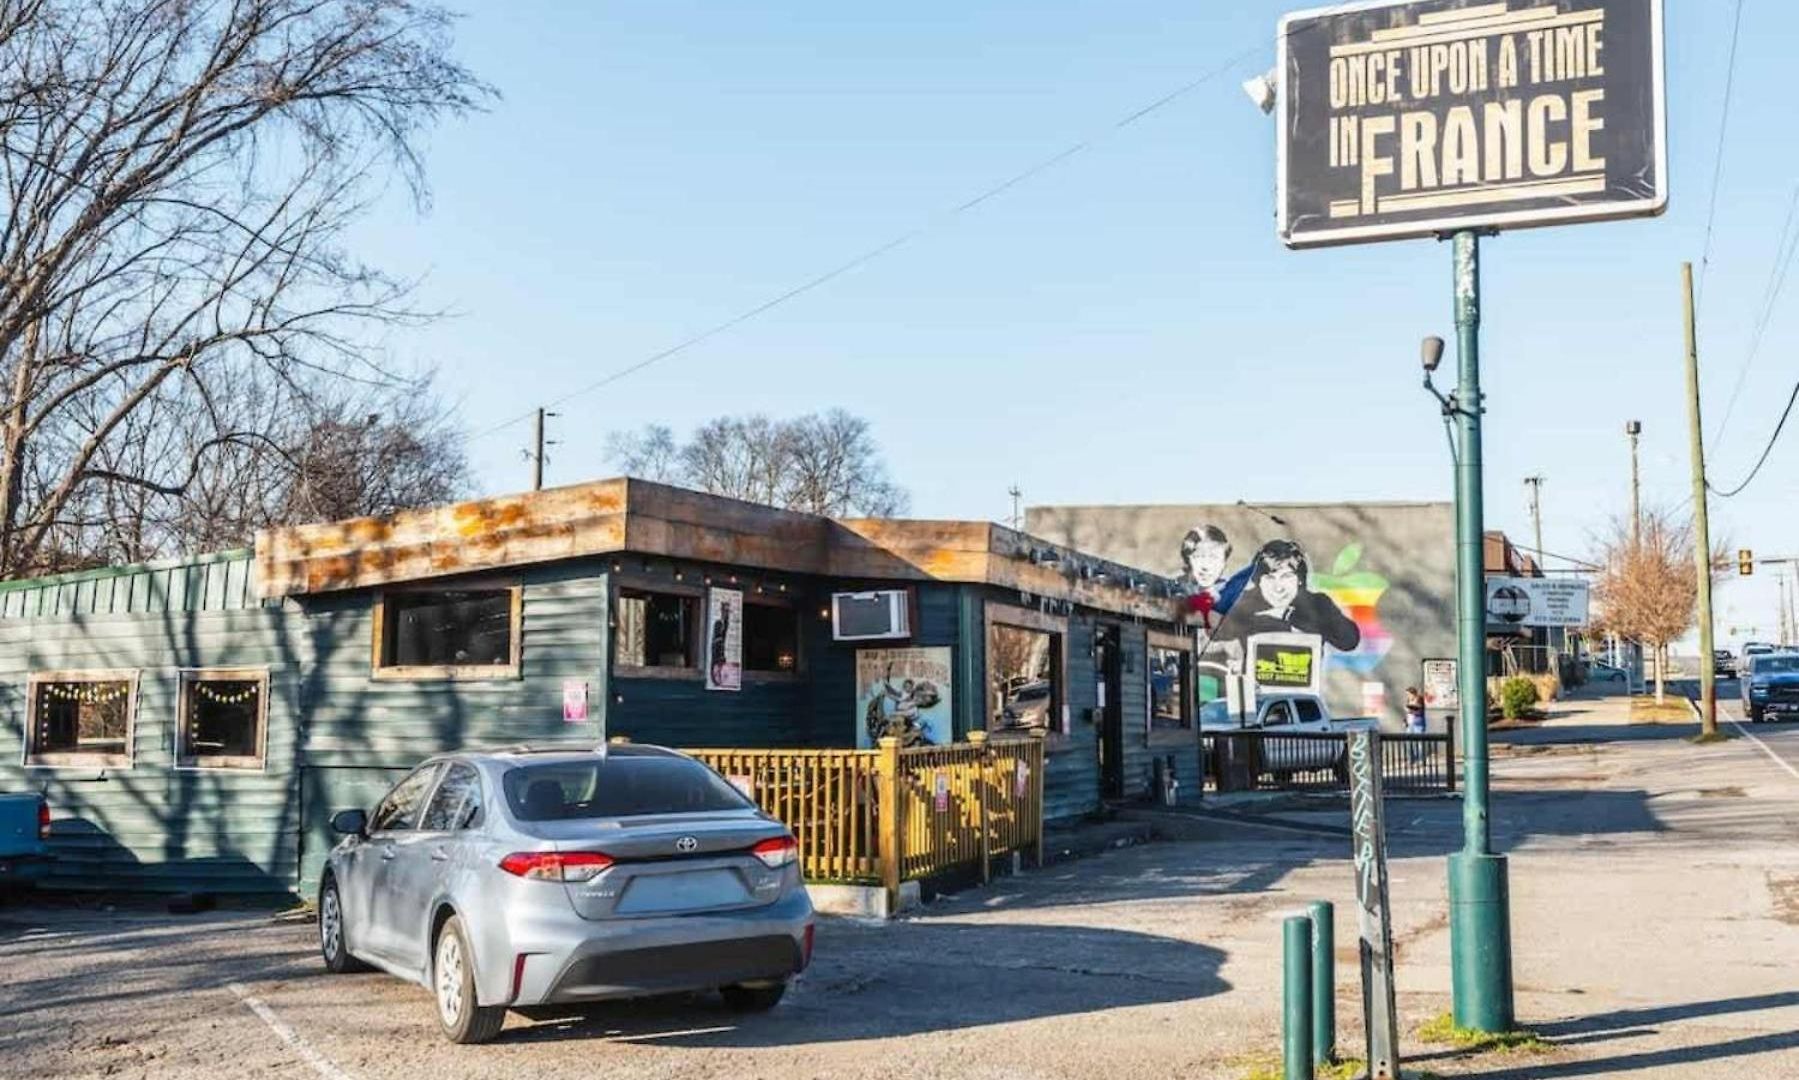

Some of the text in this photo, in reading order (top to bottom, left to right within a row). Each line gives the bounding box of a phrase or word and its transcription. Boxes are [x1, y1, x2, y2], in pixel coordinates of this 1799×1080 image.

[1330, 22, 1604, 109] ONCE UPON A TIME
[1329, 88, 1606, 215] IN FRANCE
